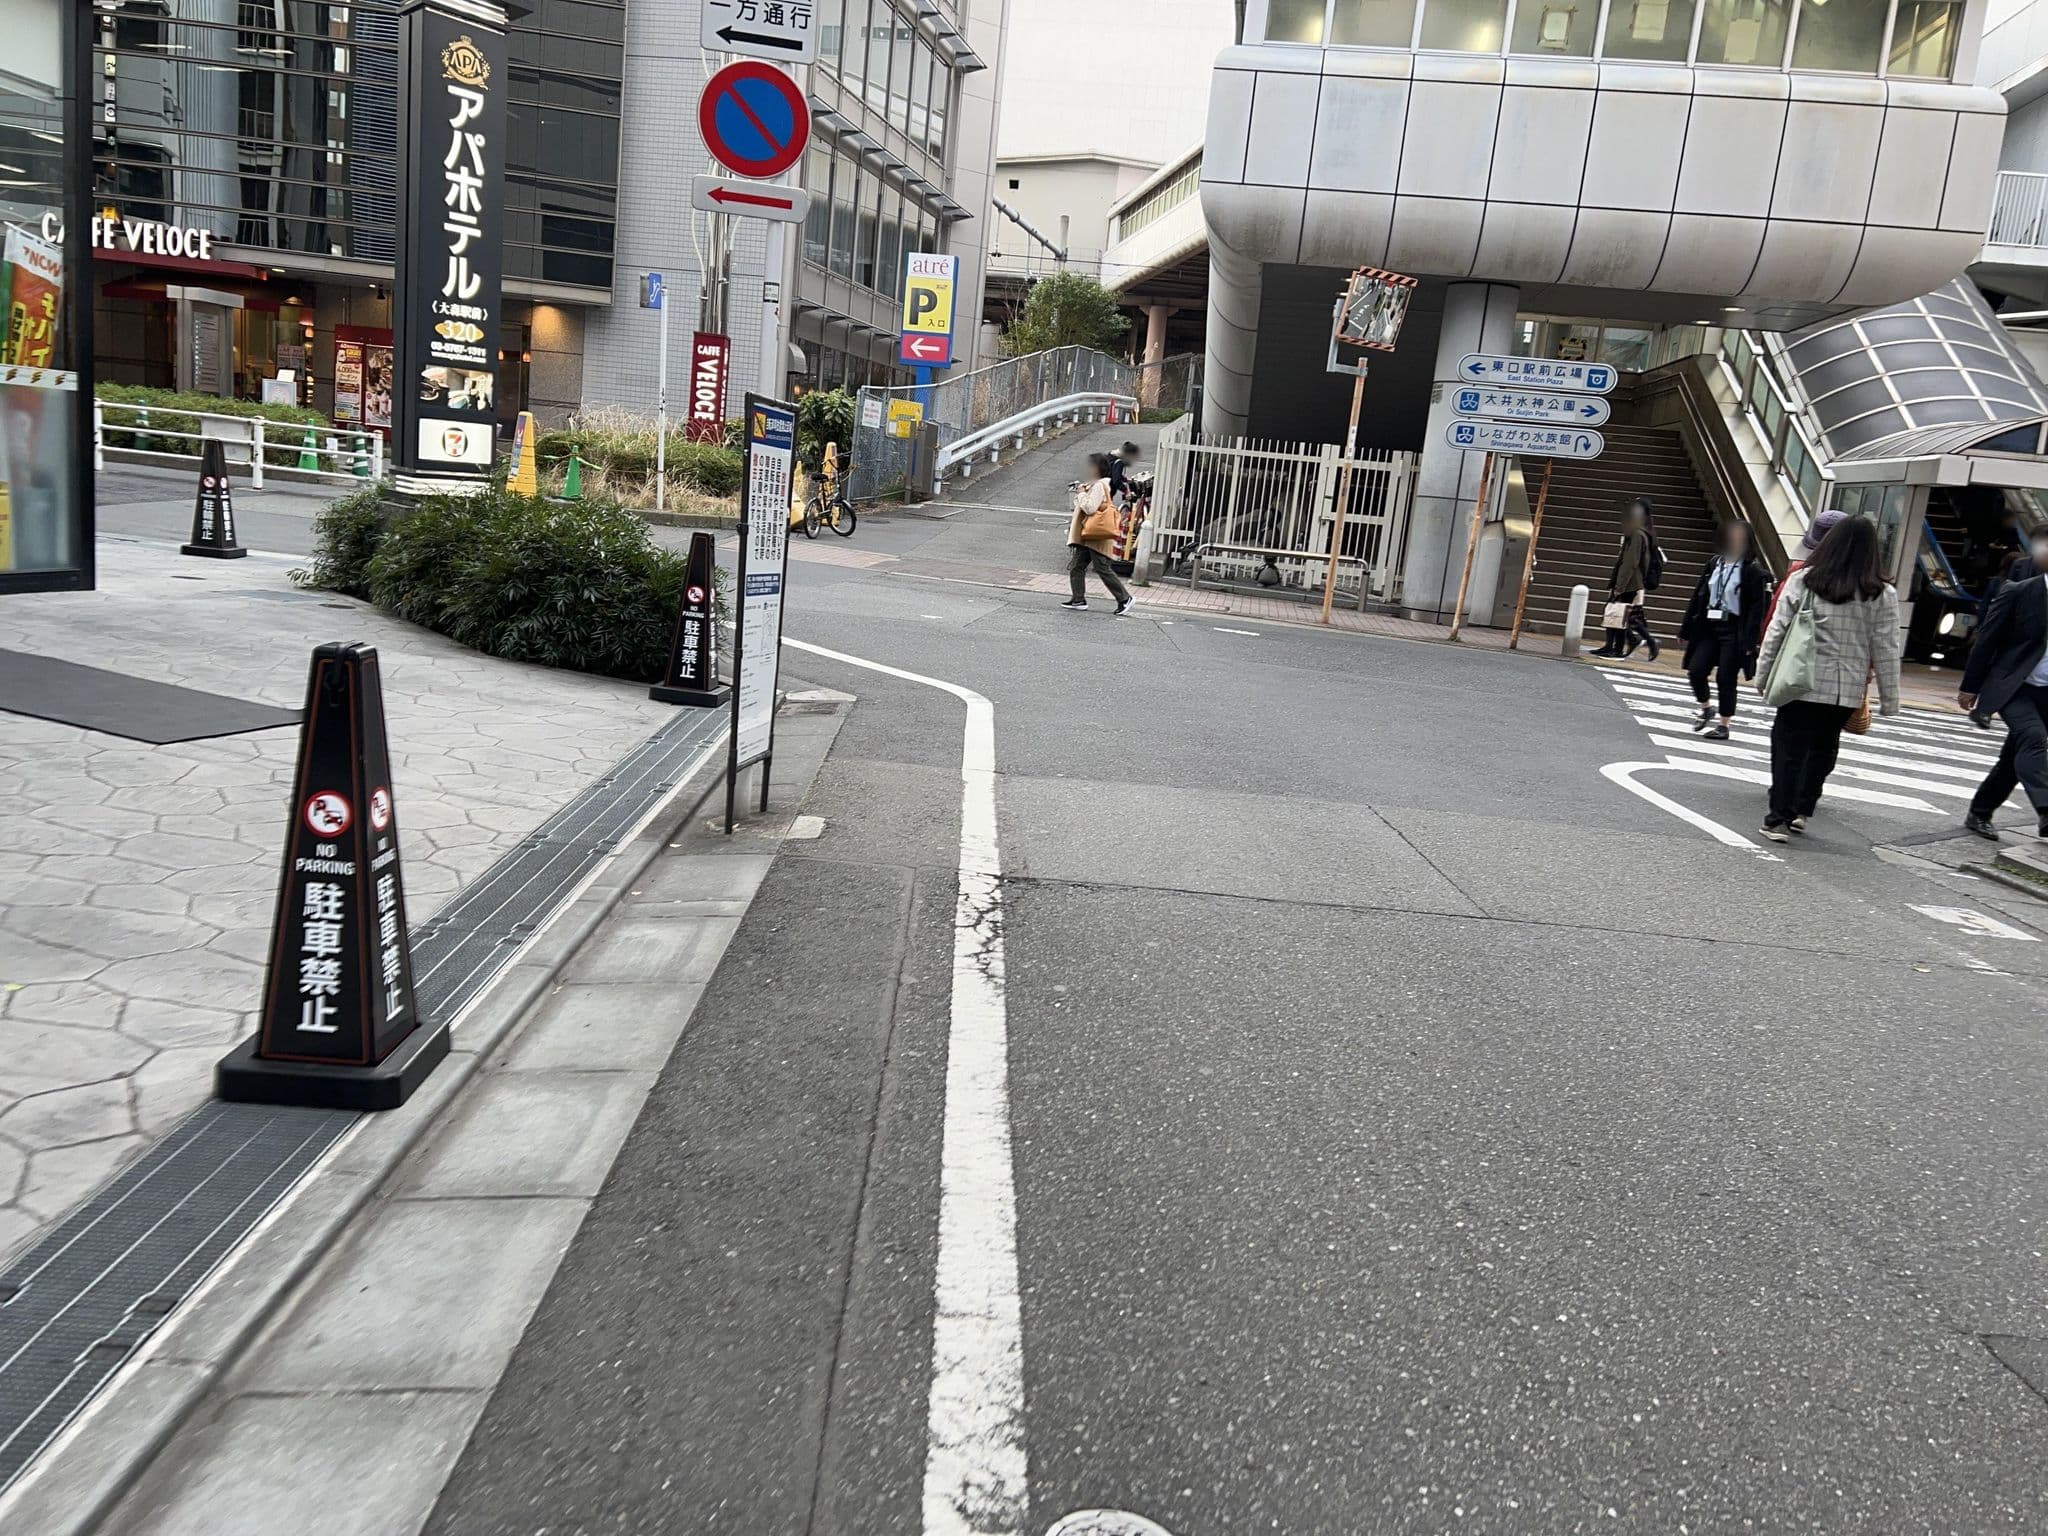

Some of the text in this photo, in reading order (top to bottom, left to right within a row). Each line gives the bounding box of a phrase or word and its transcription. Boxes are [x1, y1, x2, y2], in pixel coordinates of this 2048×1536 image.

[710, 0, 812, 29] 一方通行
[441, 84, 486, 299] アパホテル
[41, 213, 211, 260] CFE VELOCE
[912, 258, 949, 275] atré
[909, 287, 938, 325] P
[443, 319, 478, 343] 320
[927, 318, 945, 328] 入口
[697, 344, 721, 357] CAFFE
[1491, 360, 1583, 379] 東口駅前広場
[1507, 374, 1564, 385] East Station Plaza
[694, 358, 719, 421] VELOCE
[1485, 393, 1576, 411] 大井水神公園
[1479, 427, 1572, 446] しながわ水族館
[1490, 440, 1557, 451] Shinagawa Aquarium
[679, 620, 701, 679] 駐車禁止
[315, 843, 337, 859] NO
[371, 848, 396, 873] PARKING
[295, 858, 356, 876] PARKING
[295, 881, 346, 1034] 駐車禁止
[376, 872, 404, 1022] 駐車禁止
